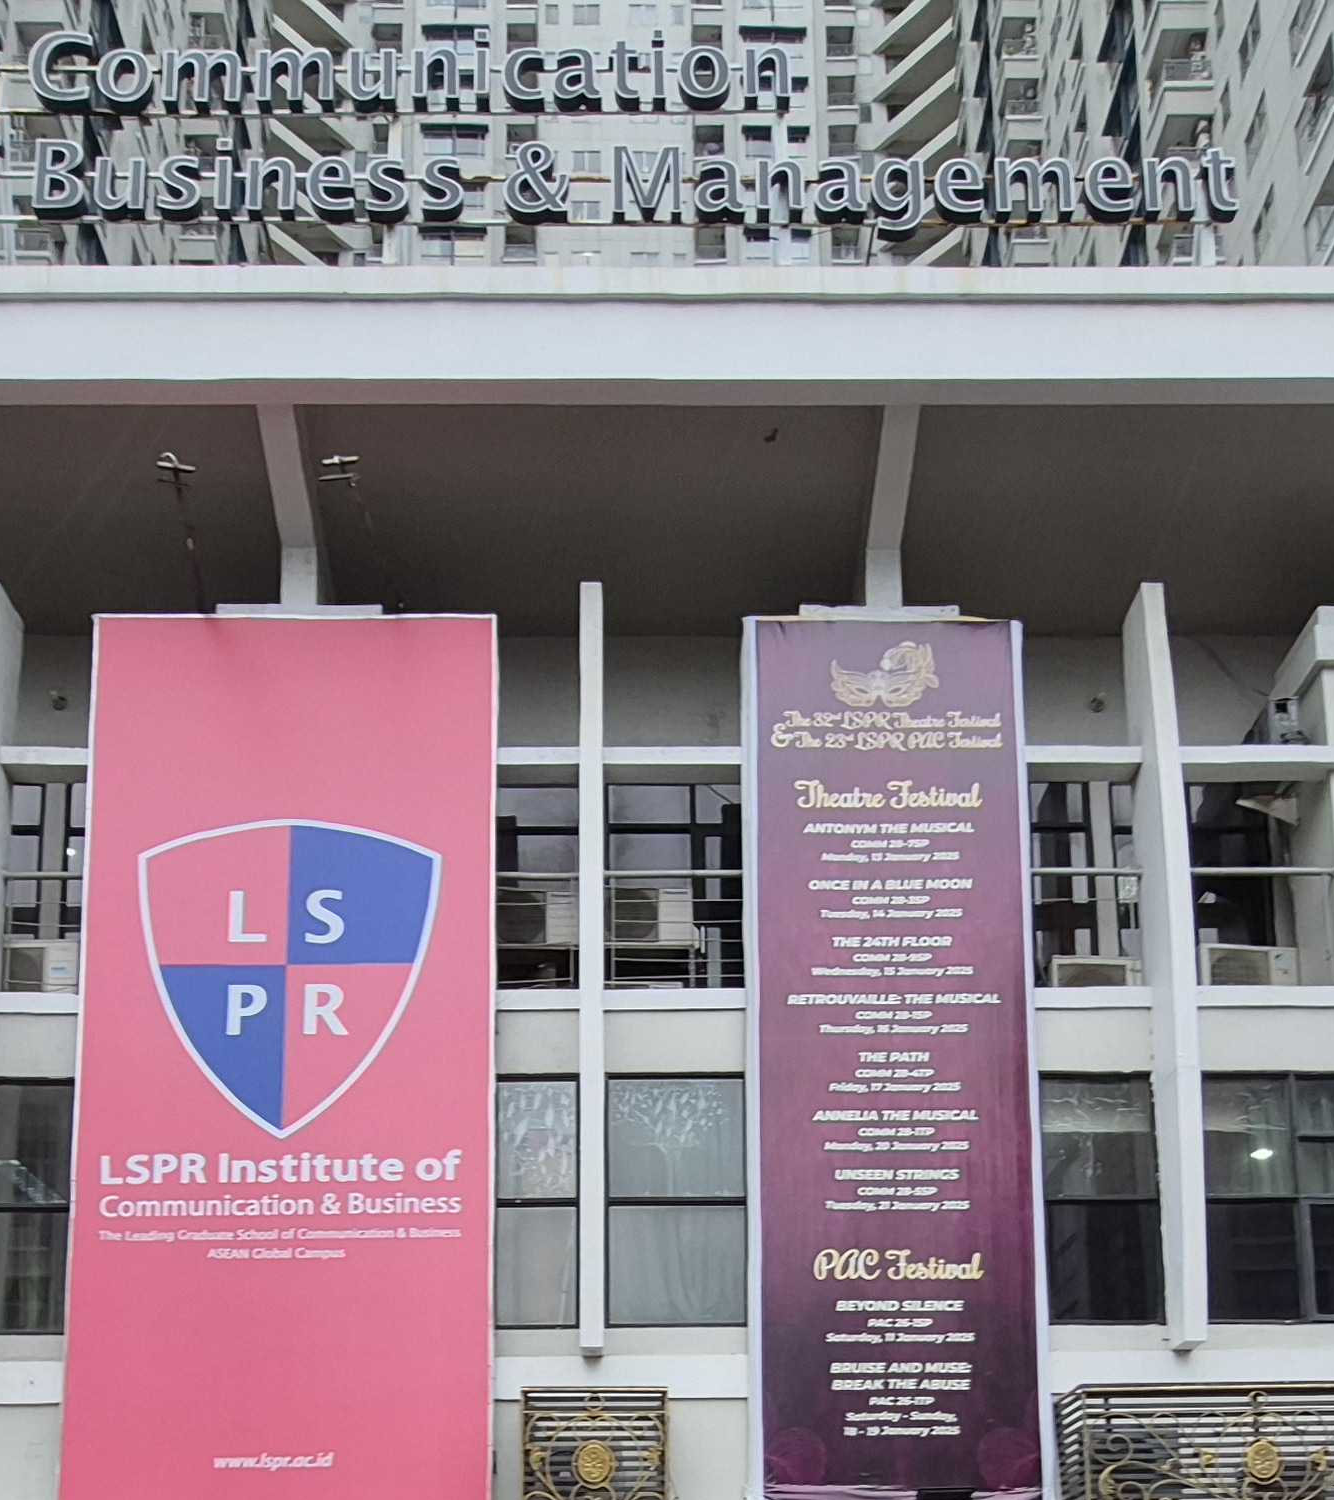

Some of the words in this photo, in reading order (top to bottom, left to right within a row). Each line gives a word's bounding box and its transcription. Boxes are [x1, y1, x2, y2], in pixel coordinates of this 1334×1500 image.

[28, 32, 793, 114] Communication
[33, 138, 463, 221] Business
[502, 142, 571, 224] &
[611, 144, 1241, 235] Management
[783, 711, 810, 728] The
[842, 710, 894, 730] LSPR
[892, 712, 945, 728] Theatre
[946, 711, 1002, 728] Festival
[770, 722, 795, 748] &
[795, 731, 822, 748] The
[854, 731, 908, 751] LSPR
[907, 732, 945, 748] PAC
[948, 731, 1003, 748] Festival
[794, 779, 886, 808] Theatre
[886, 780, 983, 808] Festival
[803, 823, 879, 835] ANTONYM
[879, 823, 909, 834] THE
[910, 822, 975, 833] MUSICAL
[821, 852, 869, 863] Monday,
[884, 852, 932, 863] January
[808, 879, 850, 891] ONCE
[852, 879, 868, 891] IN
[868, 879, 884, 891] A
[885, 879, 924, 890] BLUE
[925, 878, 973, 890] MOON
[229, 890, 267, 942] L
[305, 889, 346, 944] S
[820, 909, 870, 920] Tuesday,
[886, 909, 934, 920] January
[832, 937, 861, 948] THE
[862, 937, 901, 947] 24TH
[902, 936, 953, 947] FLOOR
[811, 966, 882, 978] Wednesday,
[897, 966, 945, 977] January
[904, 993, 934, 1004] THE
[935, 993, 1002, 1004] MUSICAL
[225, 983, 268, 1036] P
[303, 983, 349, 1036] R
[819, 1024, 875, 1035] Thursday,
[890, 1024, 939, 1035] January
[858, 1052, 888, 1063] THE
[889, 1052, 930, 1063] PATH
[828, 1082, 869, 1093] Friday,
[882, 1082, 932, 1093] January
[881, 1110, 911, 1121] THE
[912, 1110, 979, 1121] MUSICAL
[824, 1141, 873, 1152] Monday,
[890, 1141, 939, 1152] January
[100, 1153, 207, 1185] LSPR
[218, 1152, 405, 1184] Institute
[417, 1149, 462, 1181] of
[834, 1169, 893, 1180] UNSEEN
[896, 1169, 960, 1180] STRINGS
[99, 1194, 315, 1218] Communication
[321, 1193, 341, 1215] &
[347, 1192, 462, 1214] Business
[824, 1201, 875, 1212] Tuesday,
[890, 1202, 940, 1212] January
[98, 1230, 121, 1241] The
[124, 1230, 174, 1243] Leading
[177, 1229, 234, 1241] Graduate
[236, 1228, 278, 1240] School
[281, 1228, 295, 1239] of
[297, 1227, 394, 1239] Communication
[396, 1227, 407, 1238] &
[409, 1227, 461, 1238] Business
[207, 1248, 249, 1259] ASEAN
[252, 1247, 293, 1259] Global
[295, 1247, 346, 1260] Campus
[813, 1248, 882, 1281] PAC
[884, 1249, 985, 1281] Festival
[835, 1300, 900, 1312] BEYOND
[901, 1300, 964, 1311] SILENCE
[825, 1332, 883, 1344] Saturday,
[896, 1332, 945, 1343] January
[829, 1362, 886, 1374] BRUISE
[887, 1362, 923, 1374] AND
[831, 1379, 886, 1391] BREAK
[887, 1379, 918, 1390] THE
[918, 1379, 971, 1390] ABUSE
[881, 1426, 930, 1437] January
[213, 1452, 334, 1471] www.lspr.ac.id
